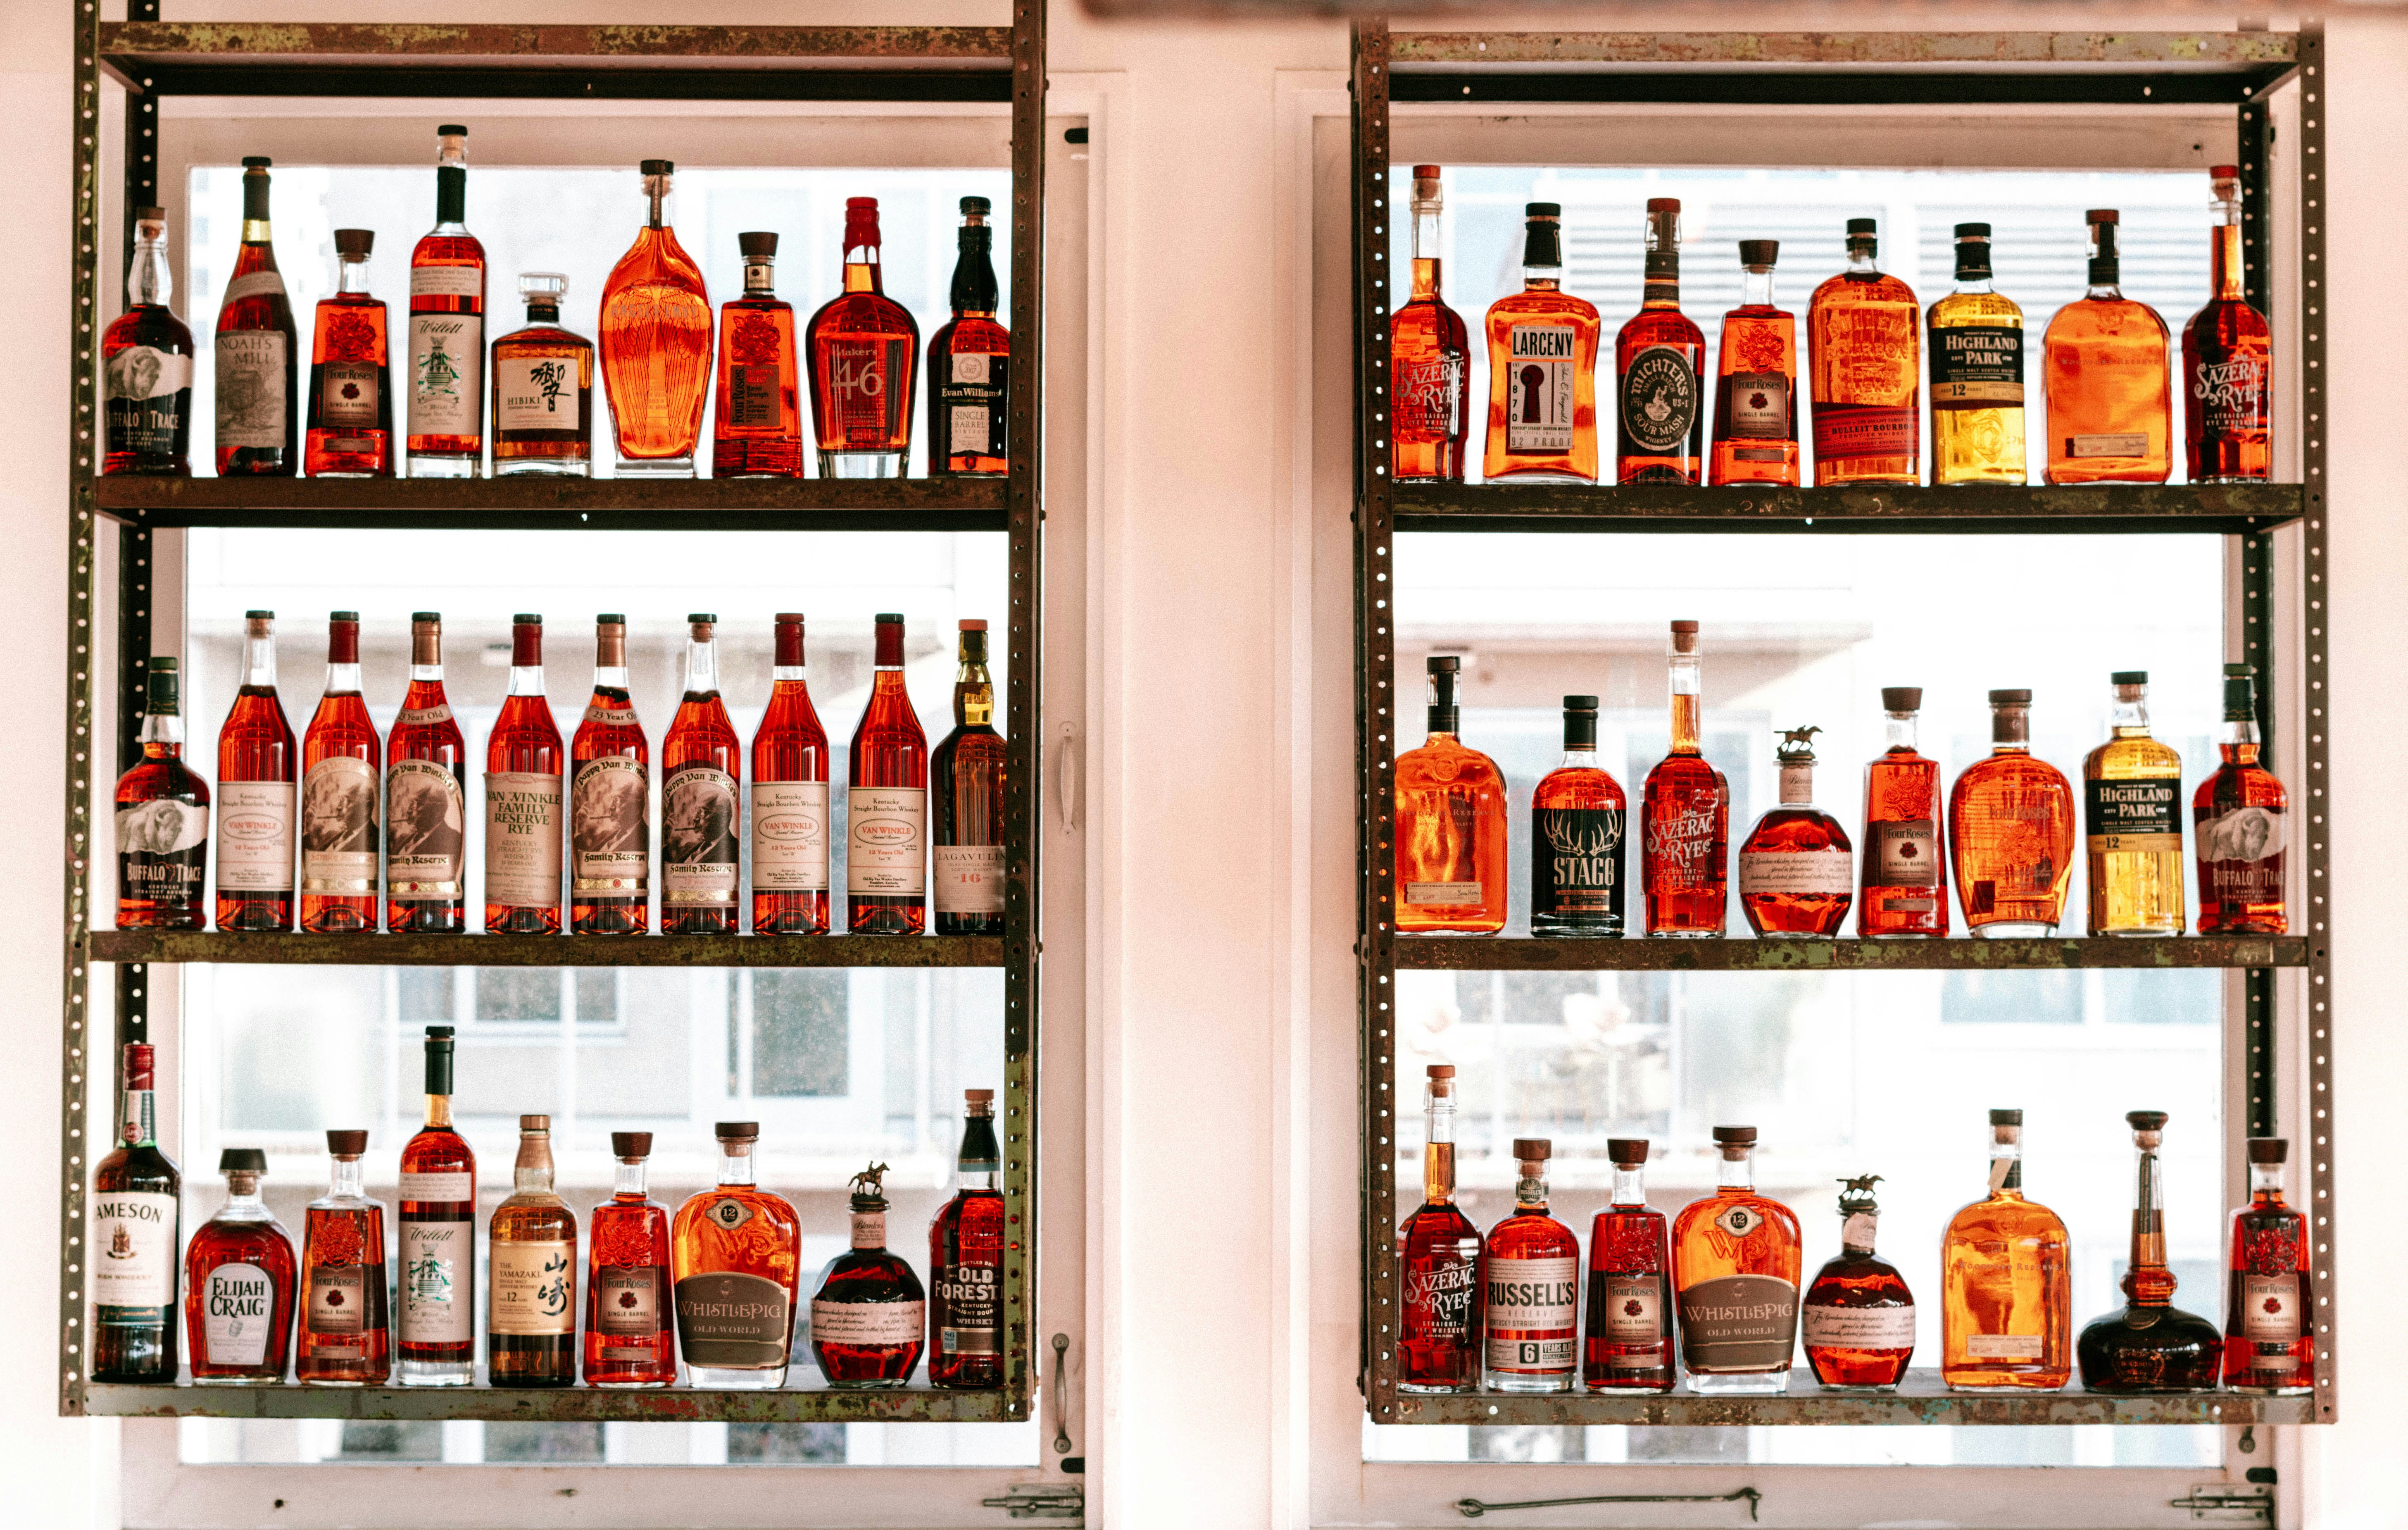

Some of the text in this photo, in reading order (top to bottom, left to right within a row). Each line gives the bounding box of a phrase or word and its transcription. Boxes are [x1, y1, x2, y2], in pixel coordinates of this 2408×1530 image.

[220, 338, 271, 350] NOAH'S
[1513, 331, 1573, 356] LARCENY
[1946, 335, 2018, 350] HIGHLAND
[835, 348, 878, 357] Maker's
[1965, 351, 2003, 365] PARK
[234, 353, 270, 365] MILL
[329, 369, 374, 380] Four Roses
[831, 359, 883, 400] 46
[1396, 359, 1465, 398] SAZERAC
[1631, 358, 1689, 396] MICHTER'S
[2194, 361, 2267, 399] SAZERAC
[1737, 379, 1781, 390] Four Roses
[733, 367, 745, 423] Four Roses
[942, 387, 999, 397] Evan Williams
[1418, 384, 1462, 412] RYE
[955, 411, 985, 420] SINGLE
[1634, 413, 1685, 436] SOUR MASH
[1832, 423, 1913, 434] BULLEIT BOURBON
[1511, 437, 1571, 446] 92 PROOF
[1644, 435, 1672, 444] WHISKEY
[407, 710, 445, 721] Year Old
[664, 772, 737, 798] Pappy Van Winkle's
[487, 790, 560, 805] VAN WINKLE
[2100, 787, 2173, 803] HIGHLAND
[497, 802, 547, 815] FAMILY
[2119, 803, 2157, 817] PARK
[495, 812, 550, 826] RESERVE
[507, 823, 534, 835] RYE
[879, 826, 911, 834] WINKLE
[1647, 815, 1716, 853] SAZERAC
[1887, 828, 1931, 839] Four Roses
[584, 852, 645, 863] Family Reserve
[937, 853, 1006, 861] LAGAVULIN
[1666, 837, 1713, 867] RYE
[127, 863, 201, 883] BUFFALO TRACE
[670, 864, 732, 874] Family Reserve
[1554, 857, 1615, 886] STAGG
[960, 873, 981, 883] 16
[97, 1203, 163, 1224] AMESON
[723, 1208, 737, 1217] 12
[1732, 1214, 1746, 1223] 12
[315, 1275, 359, 1286] Four Roses
[959, 1267, 994, 1284] OLD
[212, 1277, 264, 1297] ELIJAH
[607, 1278, 652, 1289] Four Roses
[1405, 1266, 1476, 1304] SAZERAC
[2250, 1283, 2295, 1294] Four Roses
[1488, 1282, 1574, 1307] RUSSELL'S
[1612, 1285, 1656, 1296] Four Roses
[507, 1292, 517, 1302] 12
[210, 1296, 264, 1318] CRAIG
[947, 1304, 976, 1316] STRAIGHT
[1427, 1289, 1473, 1320] RYE
[694, 1325, 761, 1335] OLD WORLD
[1707, 1327, 1775, 1337] OLD WORLD
[1523, 1344, 1535, 1363] 6
[1544, 1343, 1571, 1353] YEARS OLD
